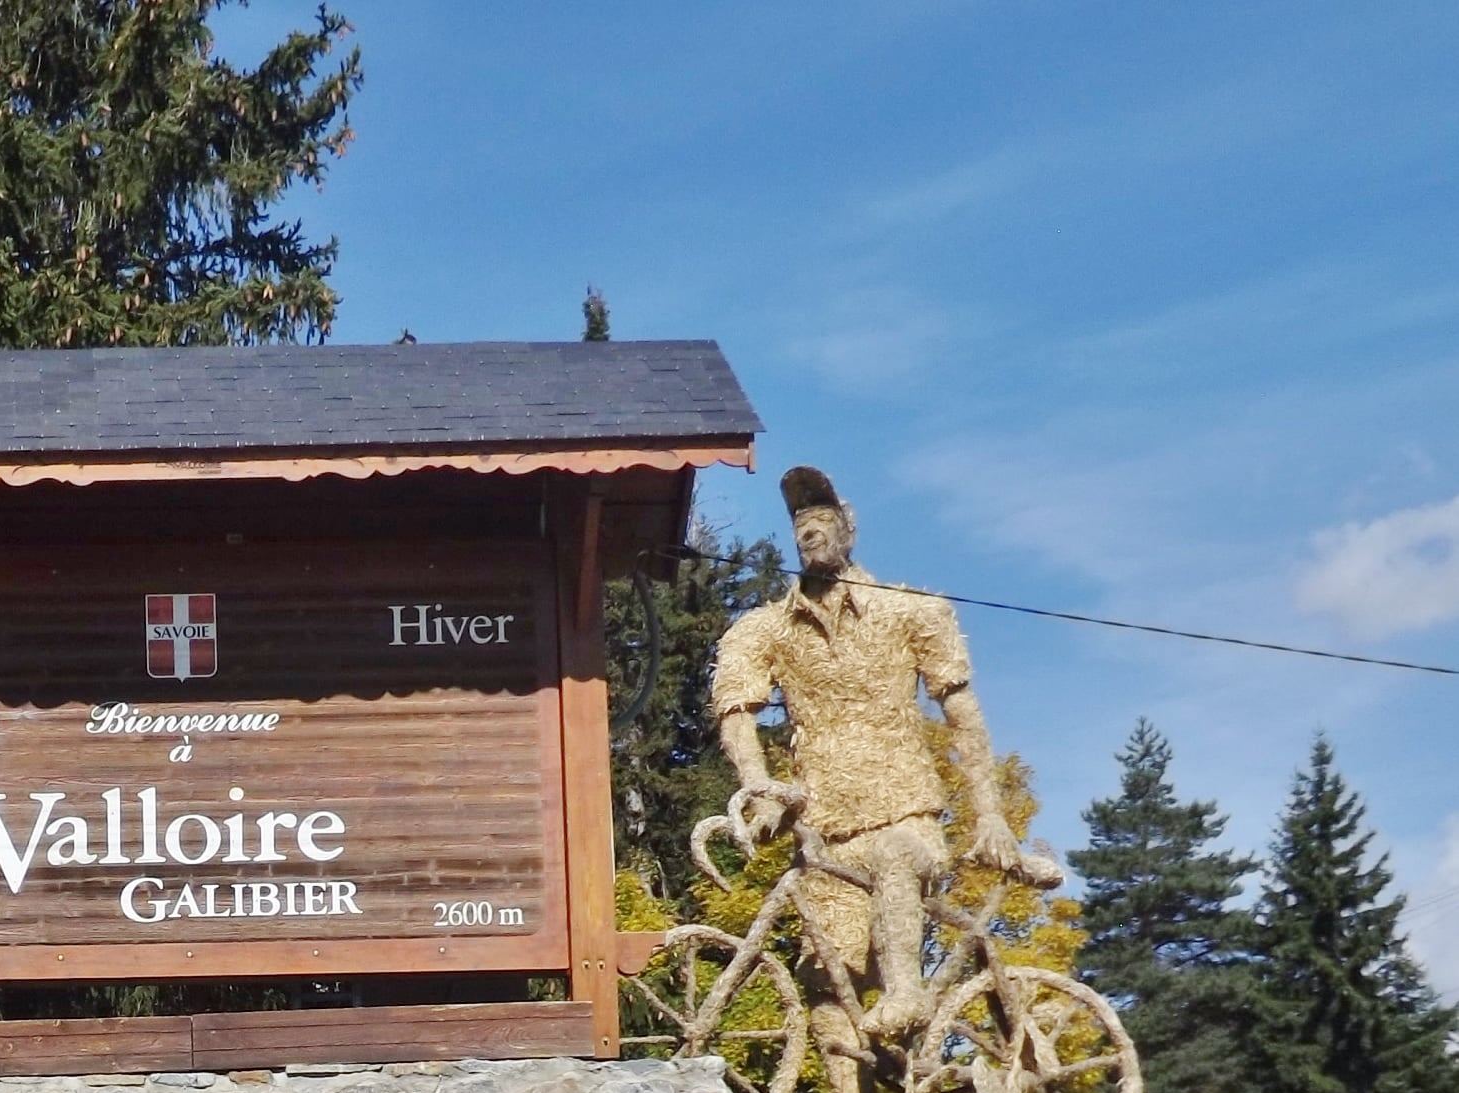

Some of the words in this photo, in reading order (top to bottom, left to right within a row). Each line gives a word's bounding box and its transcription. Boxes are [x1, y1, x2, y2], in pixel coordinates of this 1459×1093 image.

[153, 625, 210, 639] SAVOIE
[388, 604, 514, 647] Hiver
[85, 703, 281, 736] Bienvenue
[169, 735, 193, 764] à
[120, 877, 363, 923] GALIBIER
[433, 901, 493, 926] 2600
[498, 907, 525, 925] m
